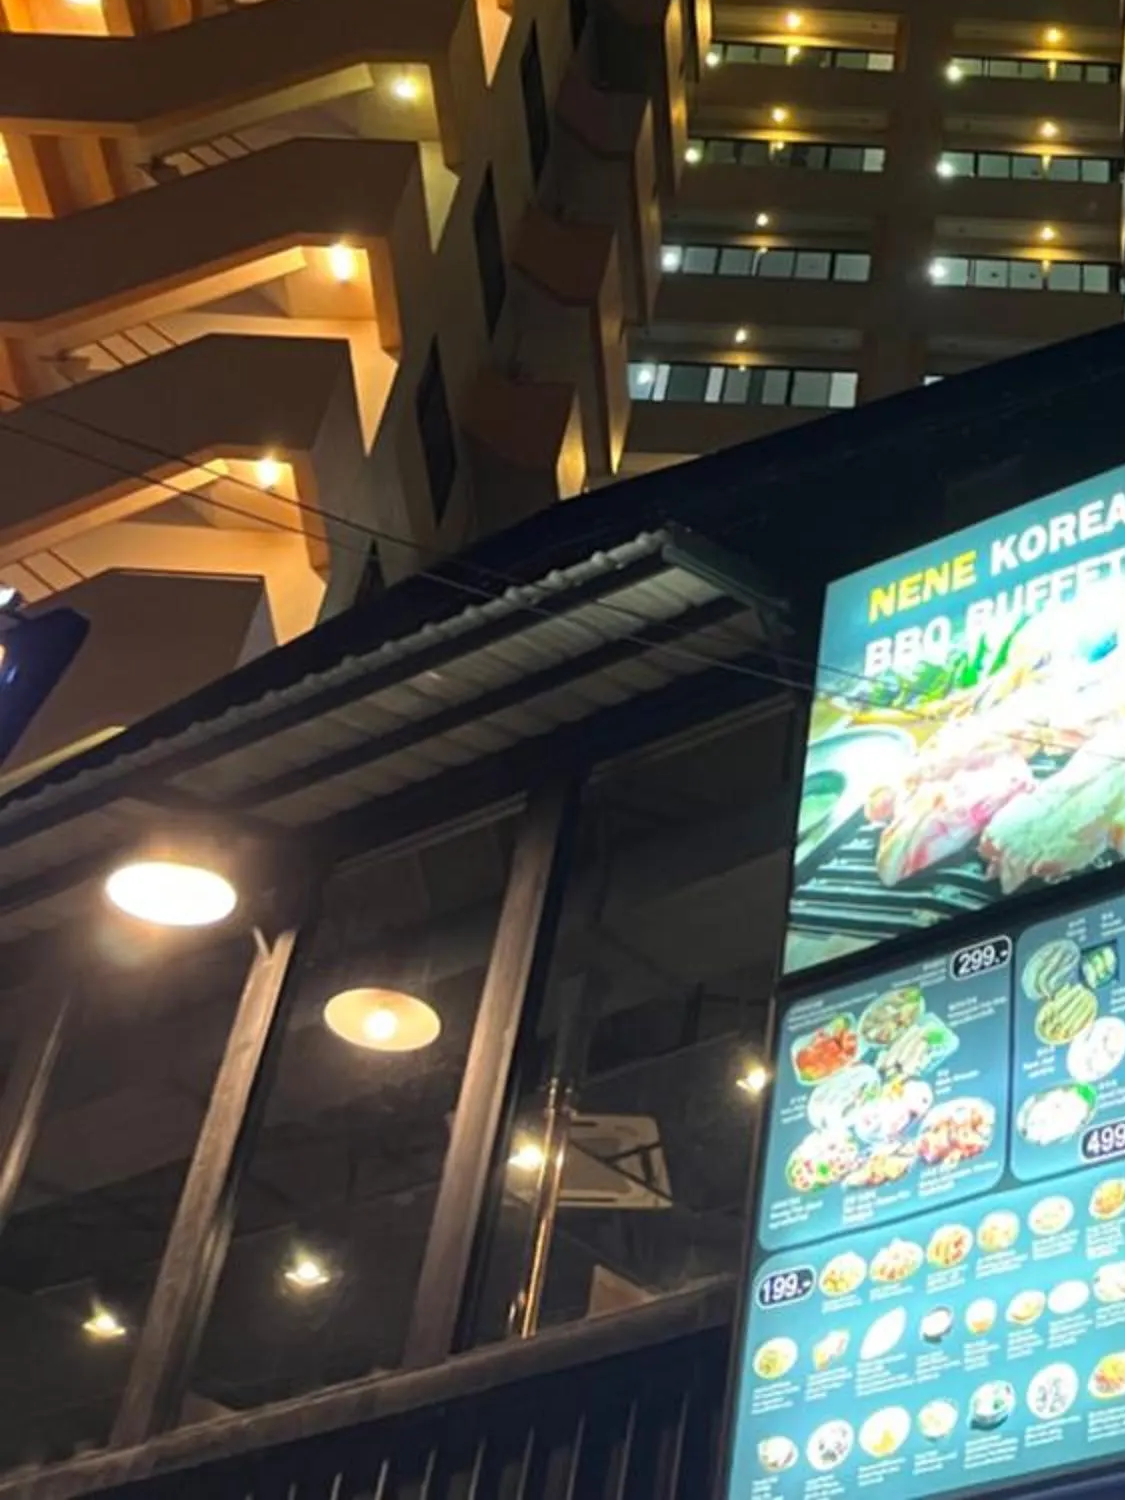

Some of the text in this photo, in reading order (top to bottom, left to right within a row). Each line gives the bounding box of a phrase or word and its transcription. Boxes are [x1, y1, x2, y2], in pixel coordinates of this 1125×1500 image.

[869, 550, 977, 624] NENE
[957, 945, 1009, 974] 299.-
[761, 1272, 812, 1303] 199.-
